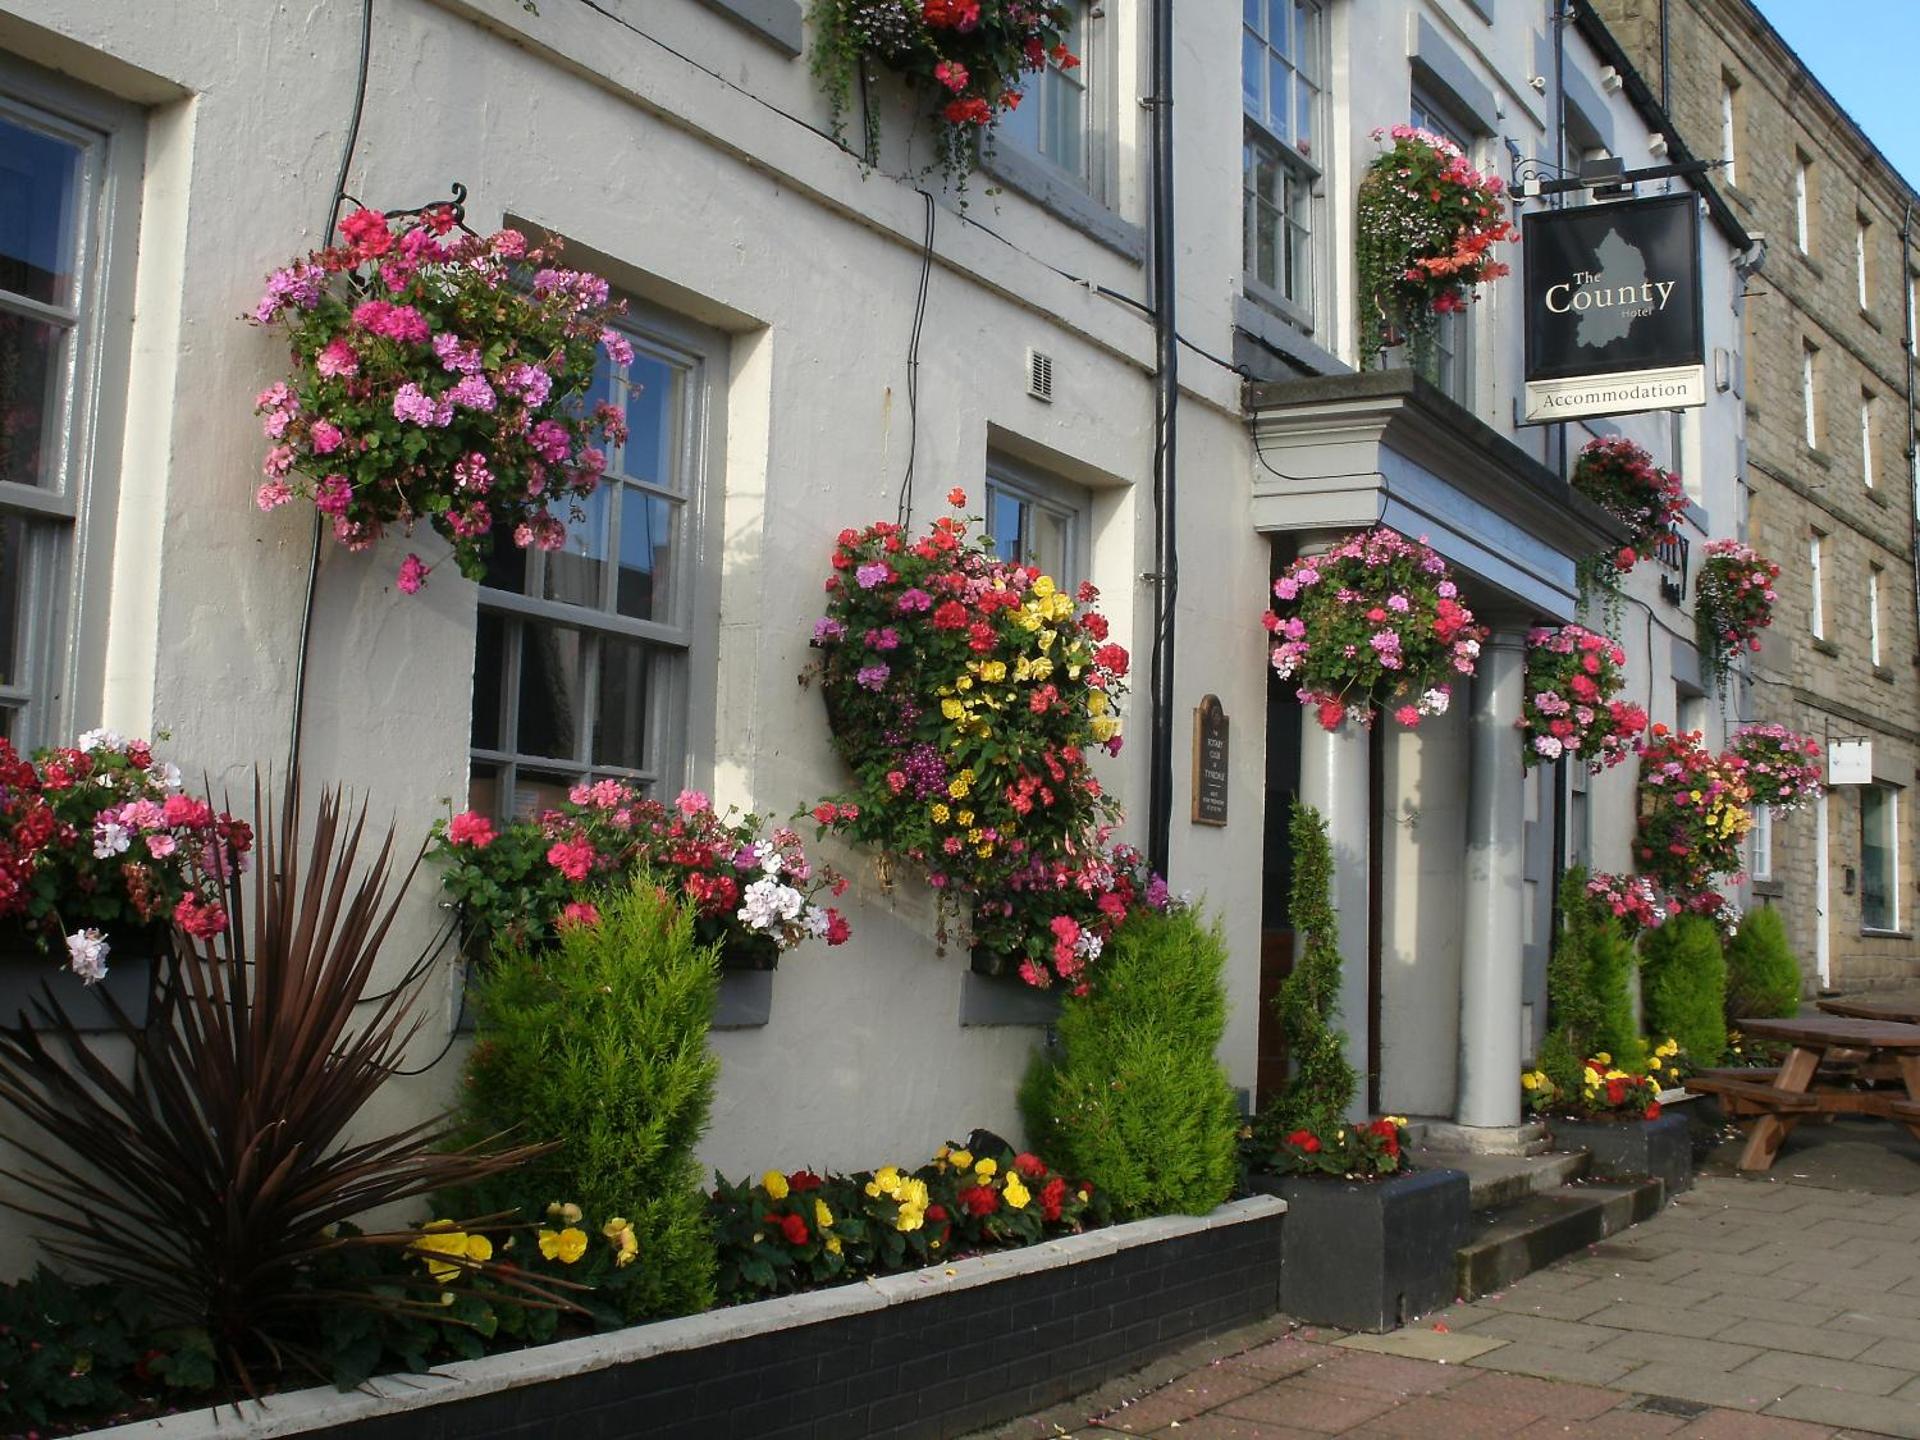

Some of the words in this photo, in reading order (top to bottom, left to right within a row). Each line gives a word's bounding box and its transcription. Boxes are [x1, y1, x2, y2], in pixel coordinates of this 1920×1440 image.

[1572, 271, 1601, 285] The
[1545, 281, 1675, 313] County
[1621, 307, 1653, 318] Hotel
[1543, 383, 1687, 408] Accommodation
